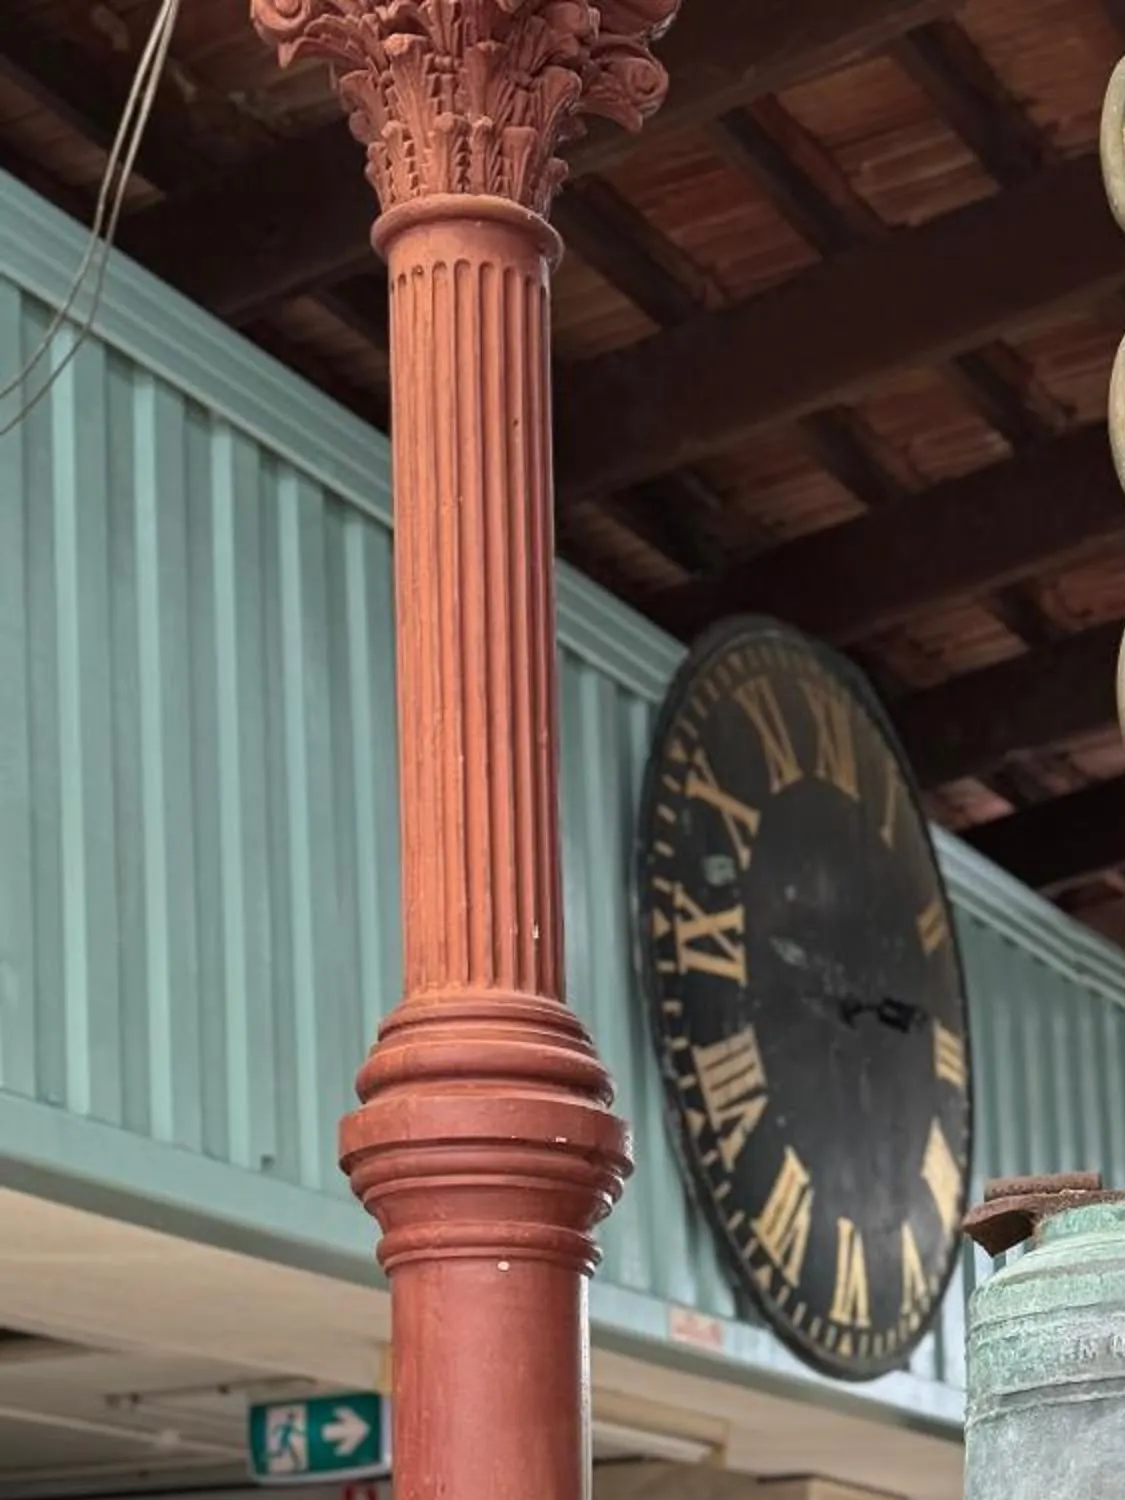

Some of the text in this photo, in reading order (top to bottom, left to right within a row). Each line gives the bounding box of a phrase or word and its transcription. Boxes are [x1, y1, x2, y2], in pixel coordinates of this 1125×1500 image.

[685, 746, 760, 871] X
[673, 882, 748, 987] IX
[691, 1022, 769, 1171] VIII
[752, 1146, 813, 1288] VII
[829, 1217, 870, 1328] VI
